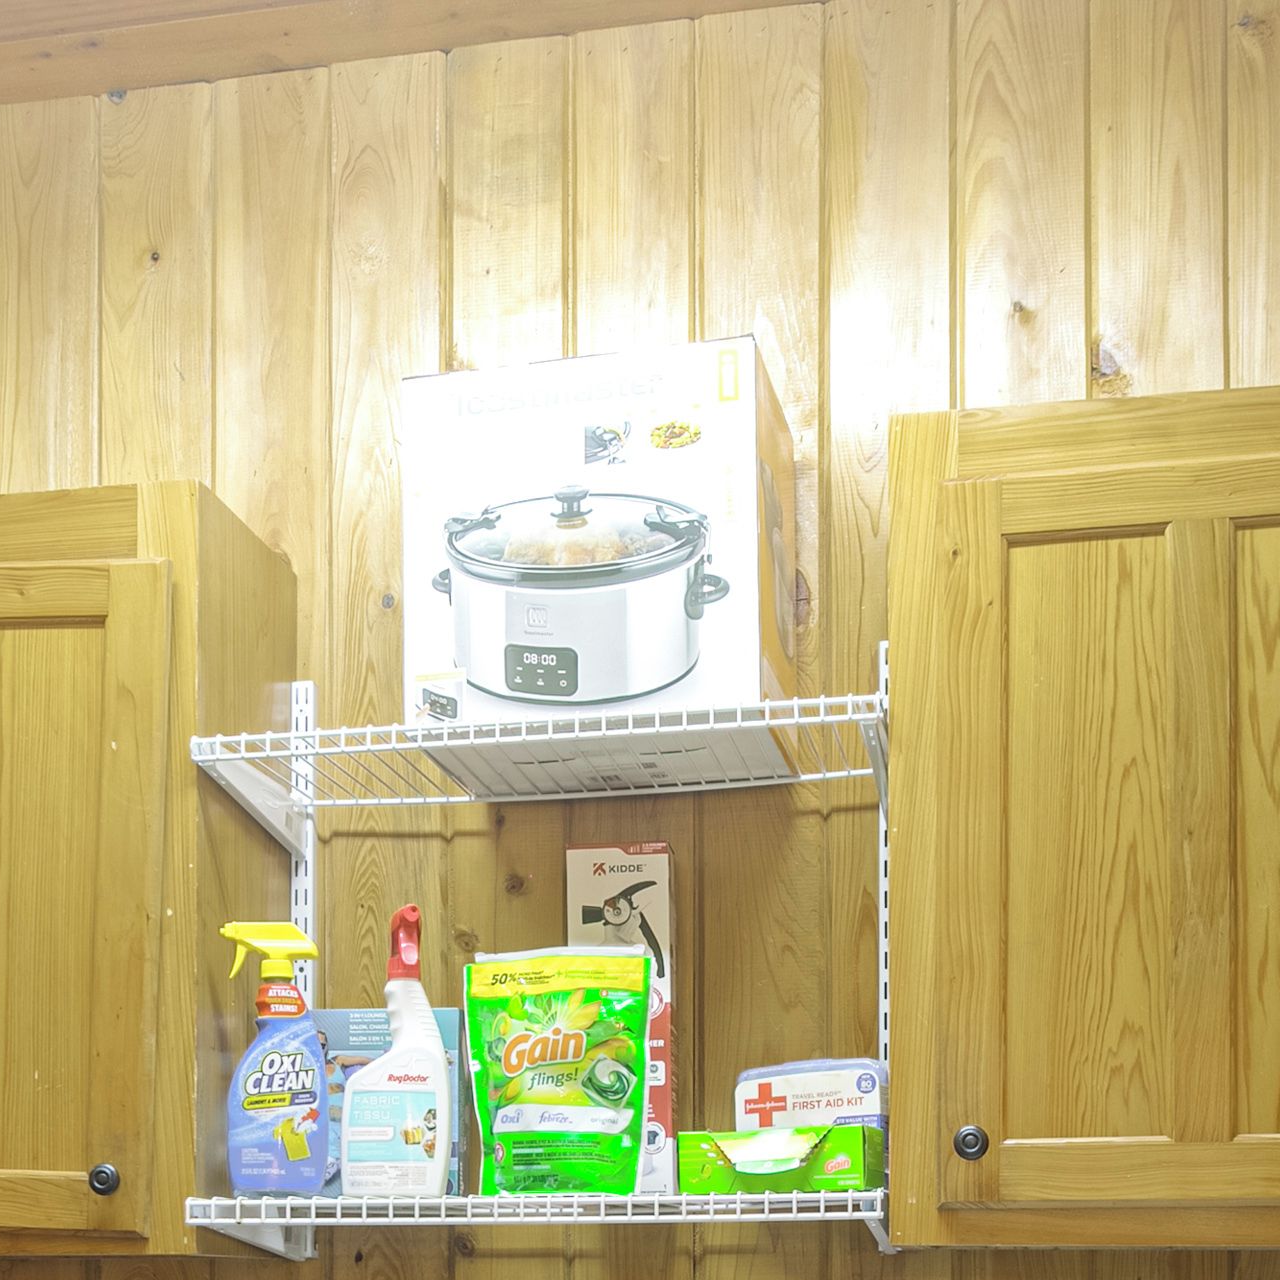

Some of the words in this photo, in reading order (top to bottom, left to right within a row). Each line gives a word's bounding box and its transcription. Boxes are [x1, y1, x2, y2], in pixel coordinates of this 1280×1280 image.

[491, 972, 517, 986] 50%
[502, 1026, 586, 1076] Gain
[261, 1051, 303, 1076] OXI
[245, 1069, 315, 1096] CLEAN
[527, 1067, 578, 1090] flings!
[353, 1096, 400, 1105] FABRIC
[792, 1099, 823, 1111] FIRST
[825, 1098, 844, 1108] AID
[847, 1096, 865, 1107] KIT
[352, 1110, 391, 1120] TISSU
[825, 1157, 851, 1174] Gain
